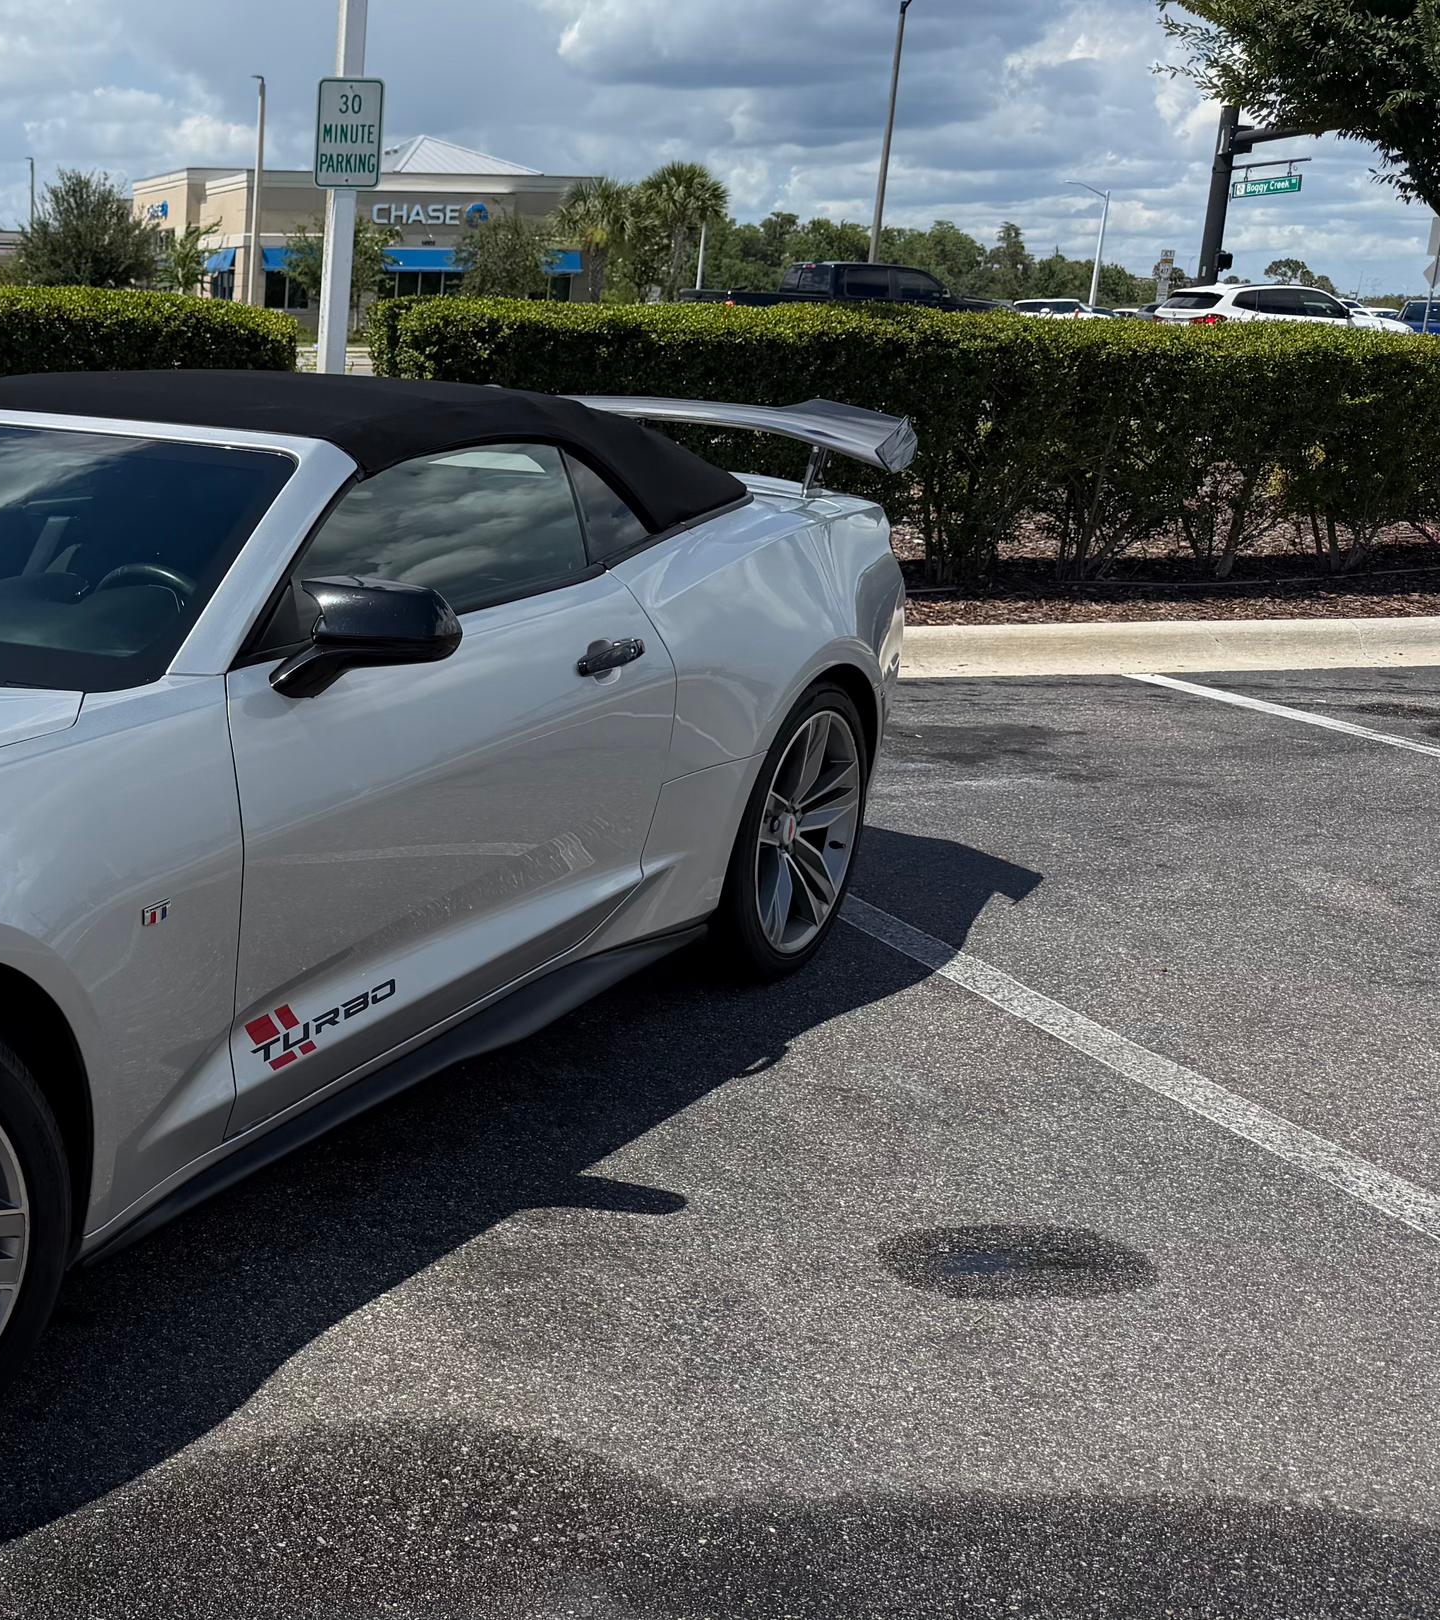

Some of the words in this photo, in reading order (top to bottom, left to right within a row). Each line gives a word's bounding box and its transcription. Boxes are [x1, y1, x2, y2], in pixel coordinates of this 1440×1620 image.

[338, 94, 362, 114] 30
[322, 124, 375, 144] MINUTE
[319, 153, 376, 173] PARKING
[1246, 182, 1268, 194] Boggy
[1269, 180, 1290, 190] Creek
[372, 203, 462, 225] CHASE
[250, 978, 396, 1062] TURBO
